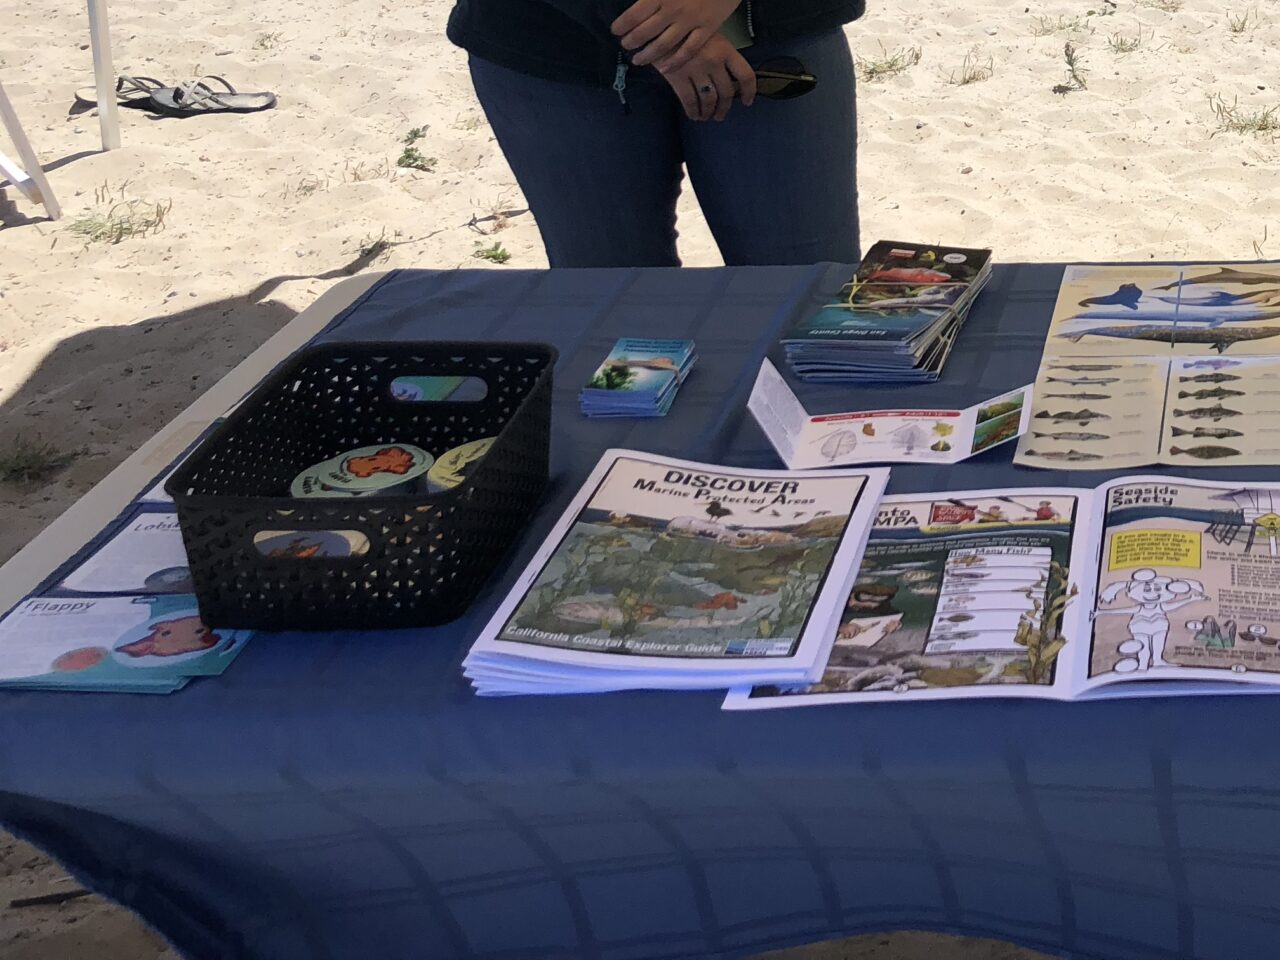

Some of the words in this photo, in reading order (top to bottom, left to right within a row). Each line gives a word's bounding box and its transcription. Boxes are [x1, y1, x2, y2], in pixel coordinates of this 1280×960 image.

[633, 478, 690, 498] Marine
[694, 488, 766, 504] Protected
[772, 494, 816, 505] Areas
[663, 470, 800, 494] DISCOVER
[1113, 486, 1179, 496] Seaside
[1112, 496, 1173, 506] Safety
[506, 625, 570, 642] California
[572, 633, 622, 647] Coastal
[624, 639, 680, 653] Explorer
[684, 642, 722, 653] Guide
